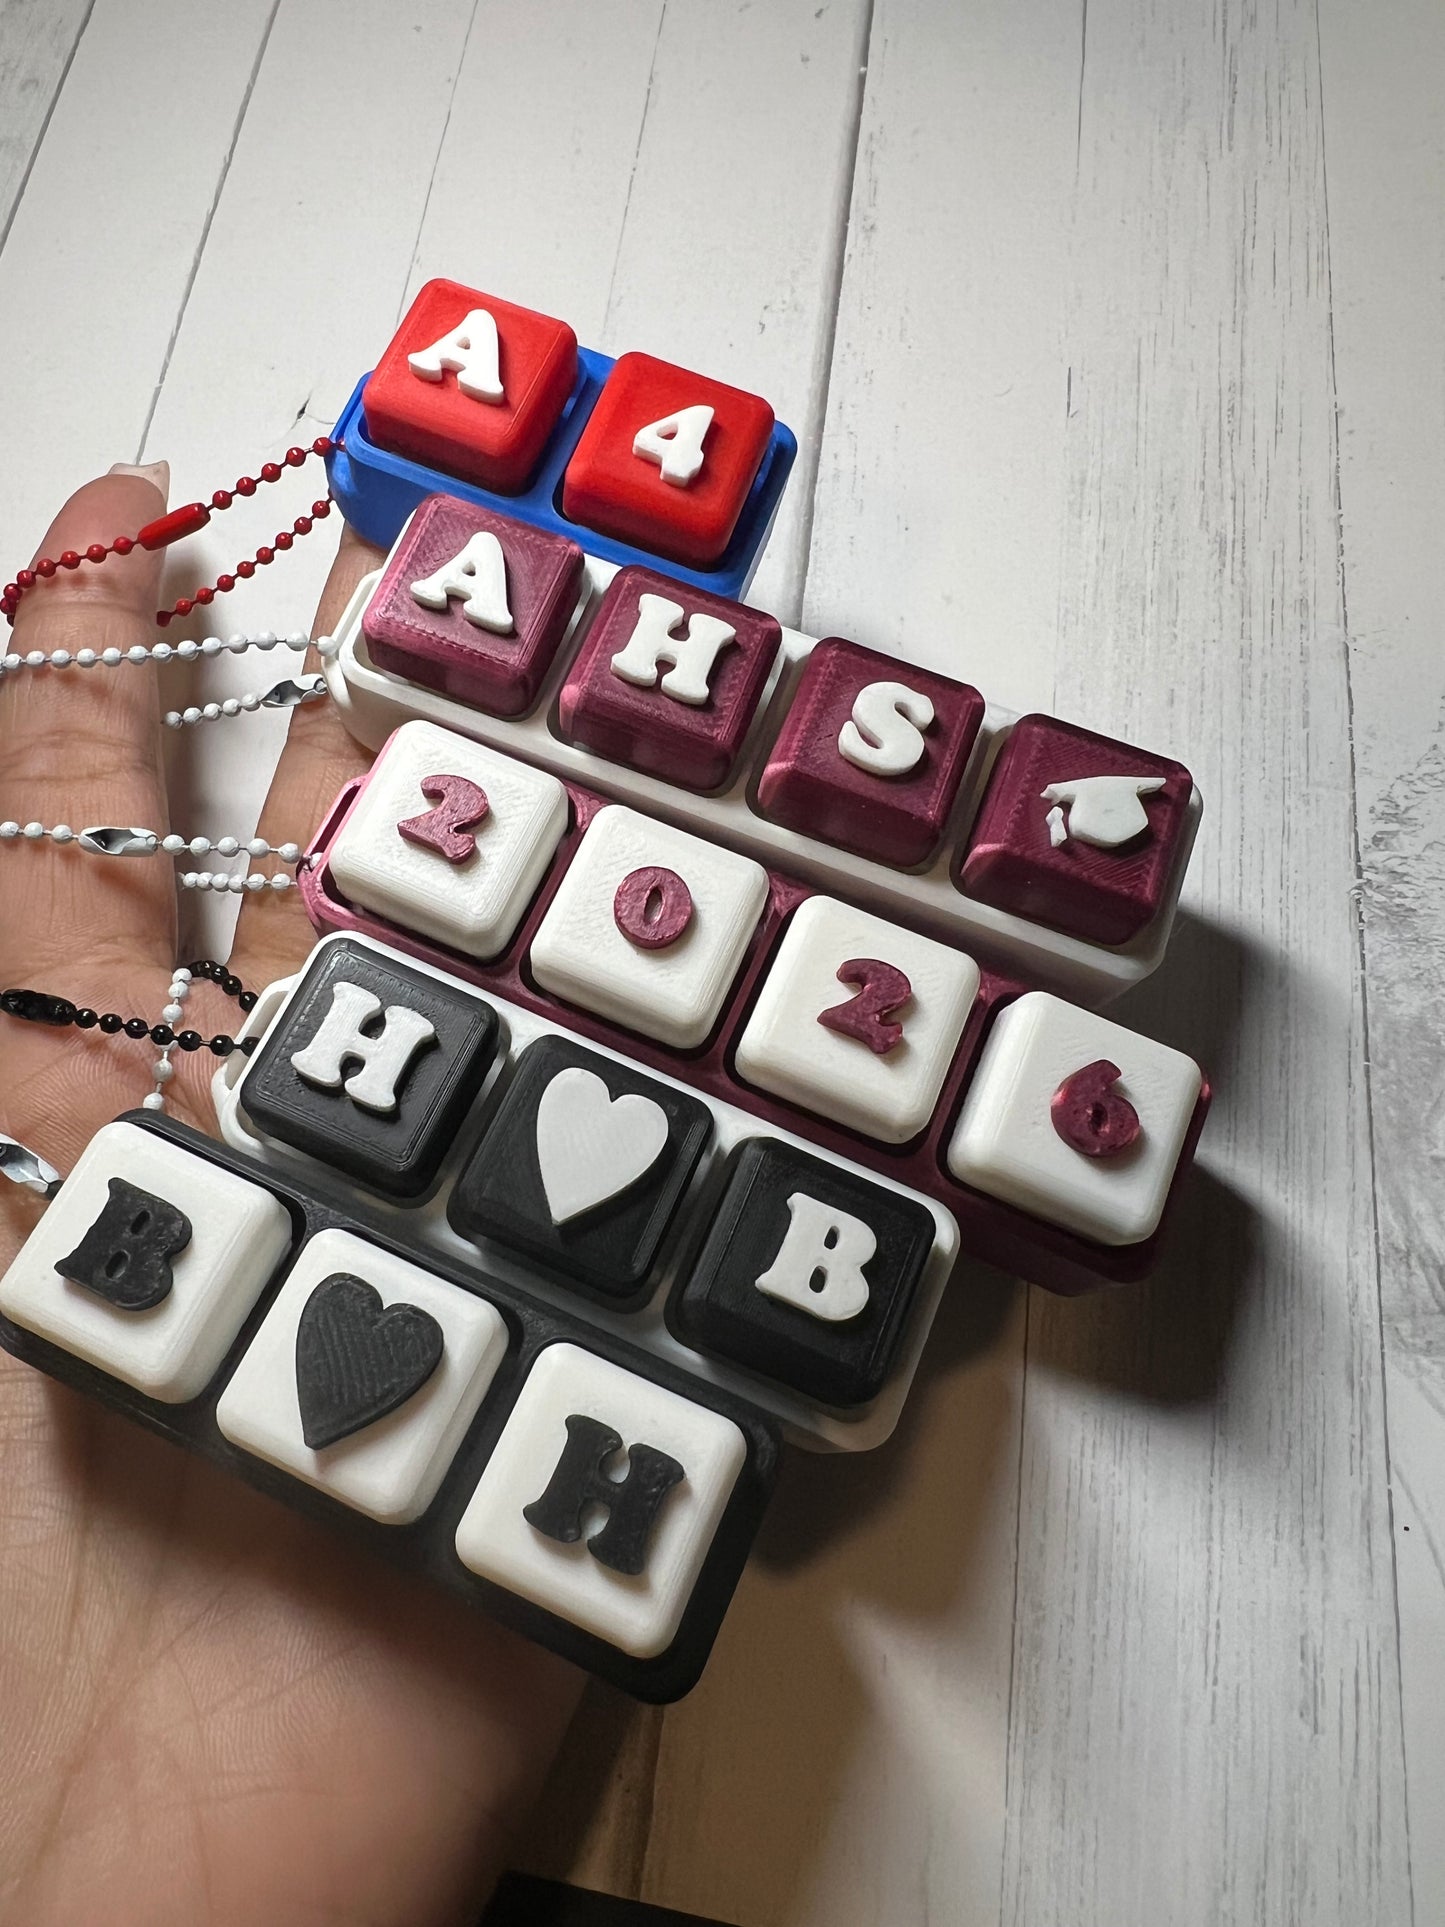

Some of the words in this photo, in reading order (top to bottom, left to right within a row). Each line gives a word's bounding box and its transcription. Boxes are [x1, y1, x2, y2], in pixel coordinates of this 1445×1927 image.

[290, 981, 436, 1112] H
[755, 1191, 879, 1322] B
[55, 1177, 193, 1313] B
[523, 1414, 685, 1576] H
